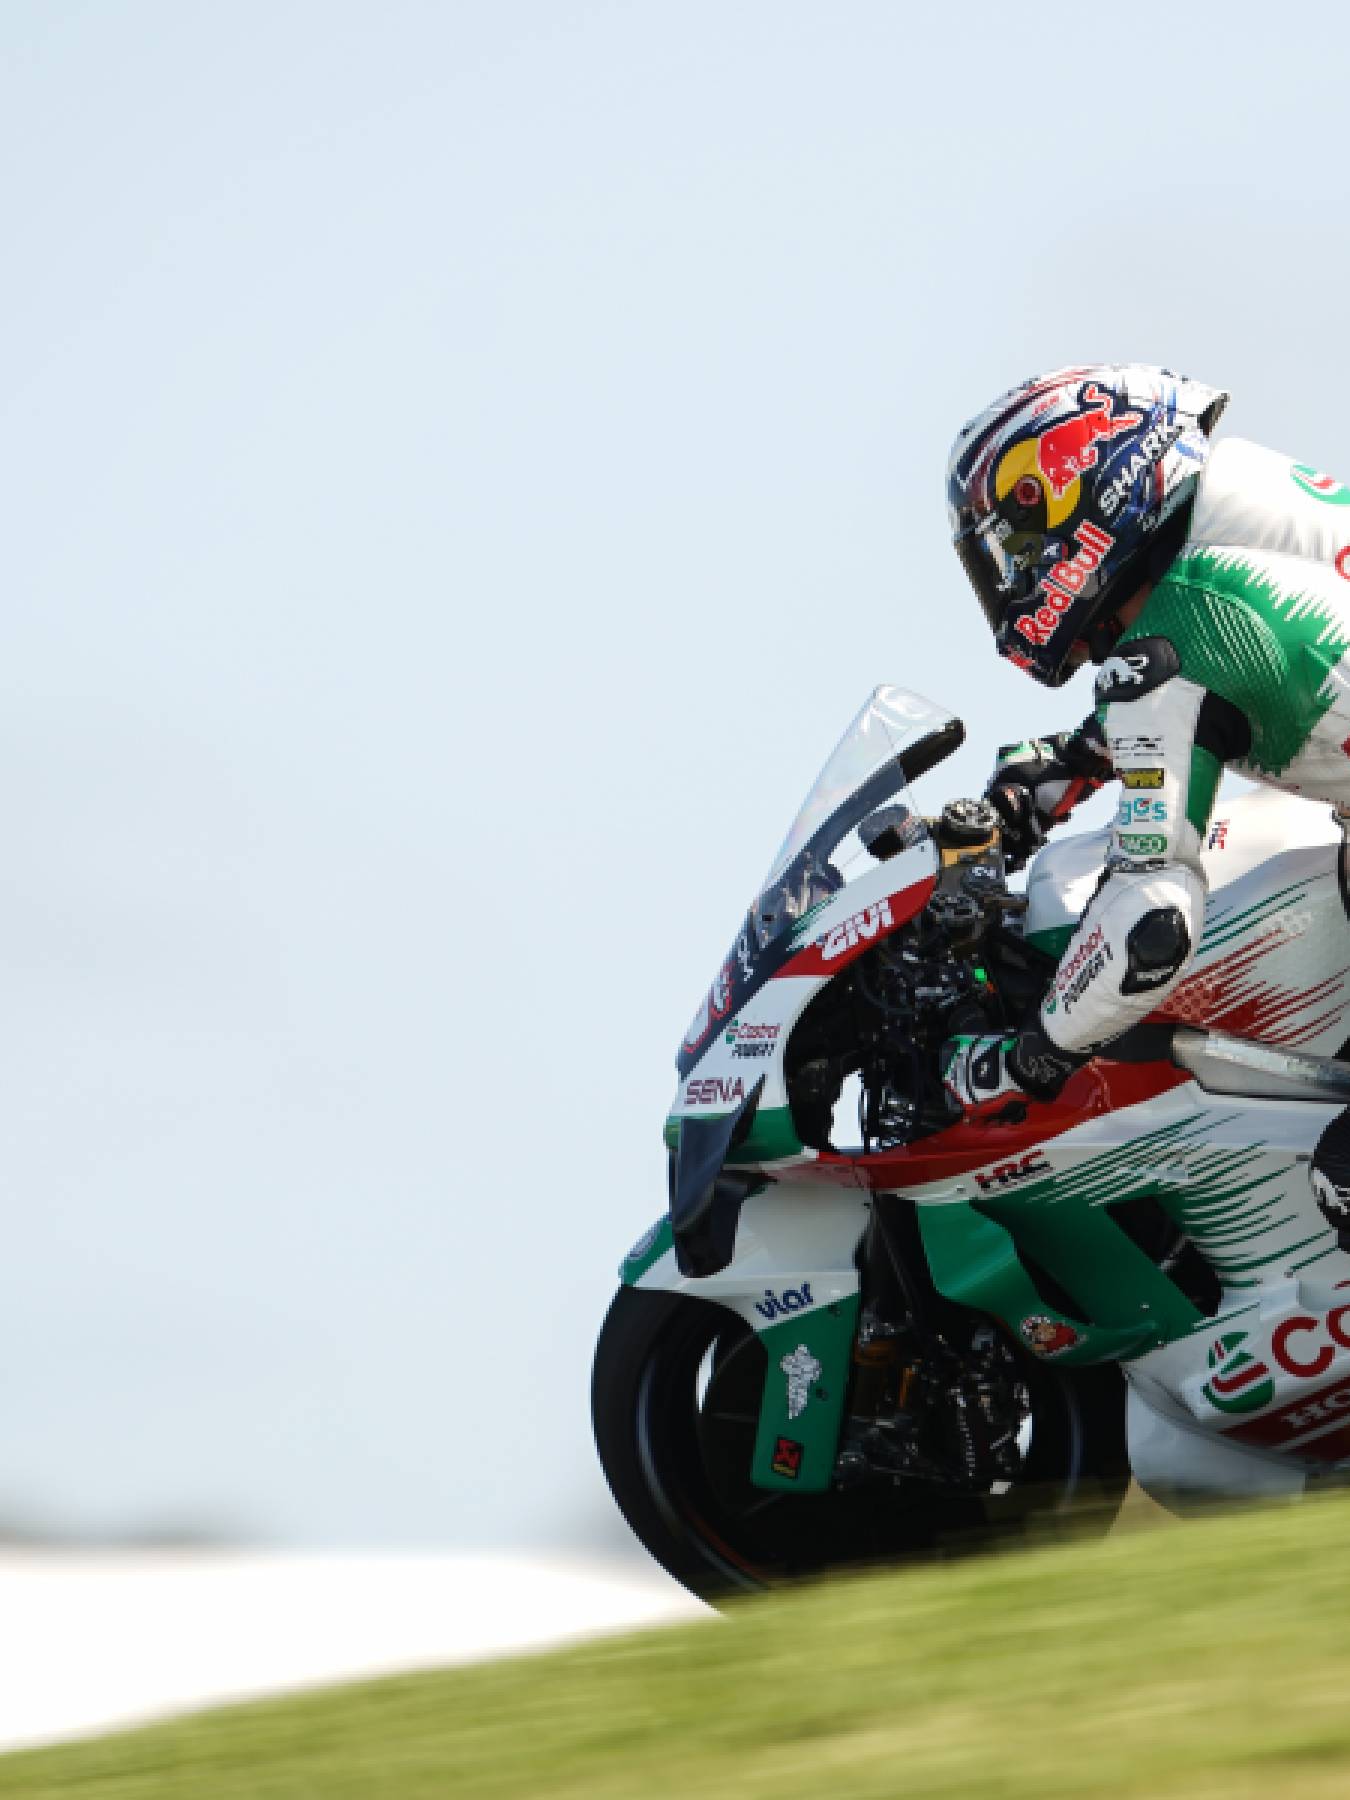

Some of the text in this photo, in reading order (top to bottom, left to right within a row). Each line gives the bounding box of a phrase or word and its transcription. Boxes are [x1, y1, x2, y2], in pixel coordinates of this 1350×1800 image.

[1099, 422, 1187, 517] SHARK
[1013, 575, 1074, 646] Red
[1047, 517, 1116, 594] Bull
[821, 898, 894, 960] GIVI
[684, 1076, 745, 1105] SENA
[975, 1150, 1054, 1193] HRC
[755, 1281, 815, 1320] viar
